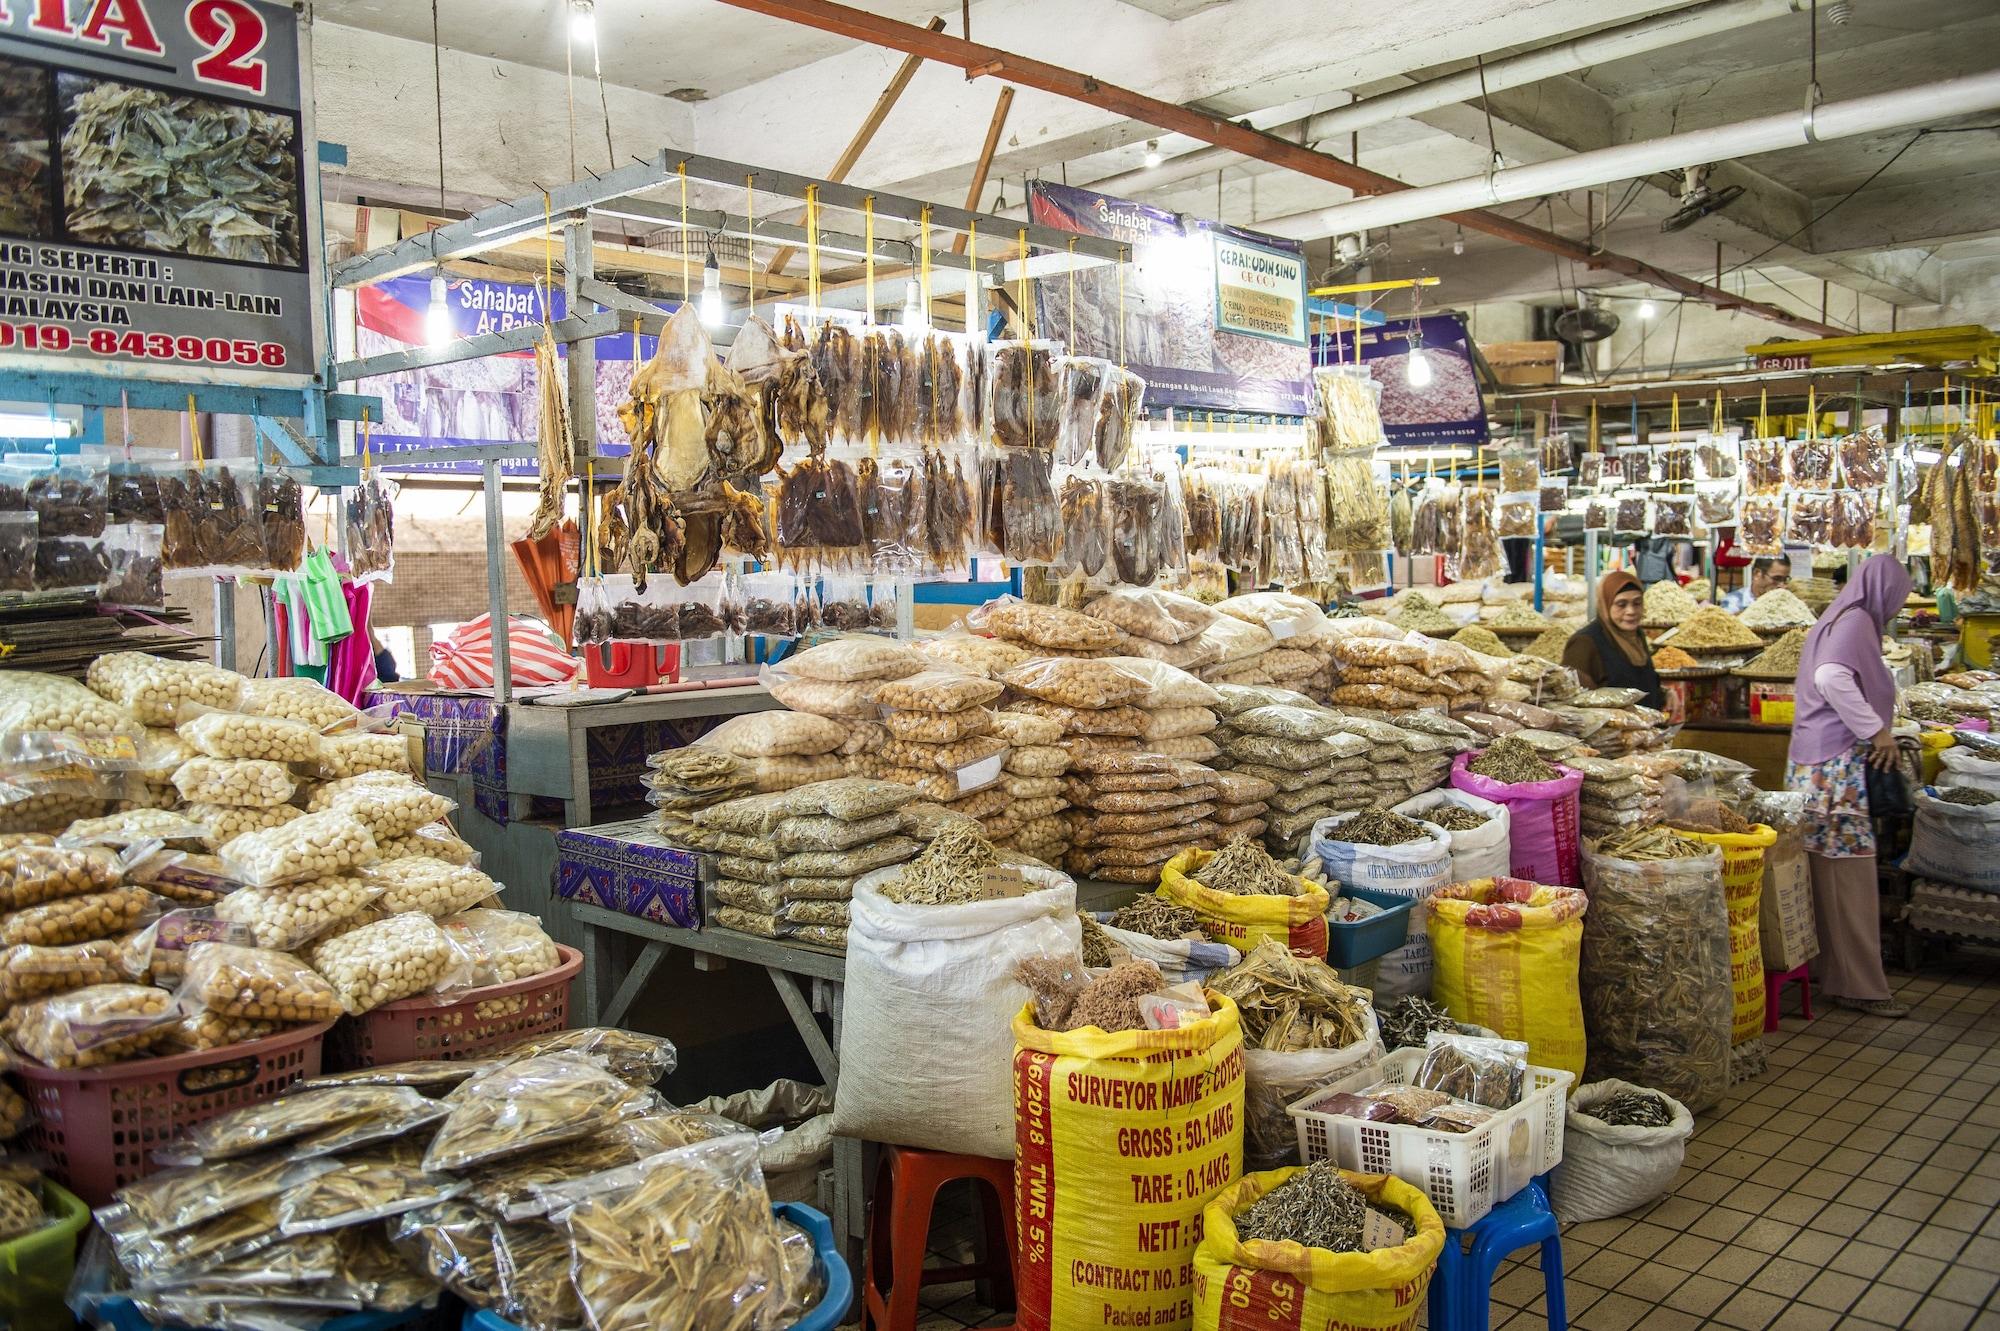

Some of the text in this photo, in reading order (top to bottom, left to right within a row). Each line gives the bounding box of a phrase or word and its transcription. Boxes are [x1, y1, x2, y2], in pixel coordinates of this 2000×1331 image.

[187, 0, 266, 95] 2
[1099, 206, 1151, 232] Sahabat
[40, 247, 158, 280] SEPERTI
[163, 266, 173, 282] :
[0, 270, 282, 317] ASIN DAN LAIN-LAIN
[0, 295, 131, 327] ALAYSIA
[460, 281, 534, 314] Sahabat
[476, 312, 497, 335] Ar
[0, 321, 286, 367] 019-8439058
[1229, 922, 1247, 939] For:
[1067, 1071, 1157, 1111] SURVEYOR
[1162, 1073, 1204, 1110] NAME
[1118, 1102, 1233, 1158] GROSS : 50.14KG
[1030, 1164, 1048, 1219] TWR
[1131, 1152, 1230, 1203] TARE : 0.14KG
[1029, 1225, 1045, 1264] 5%
[1138, 1220, 1180, 1253] NETT
[1184, 1226, 1188, 1247] :
[1071, 1258, 1193, 1292] (CONTRACT NO. BE
[1104, 1300, 1193, 1327] Packed and Ex
[1268, 1279, 1295, 1321] 5%
